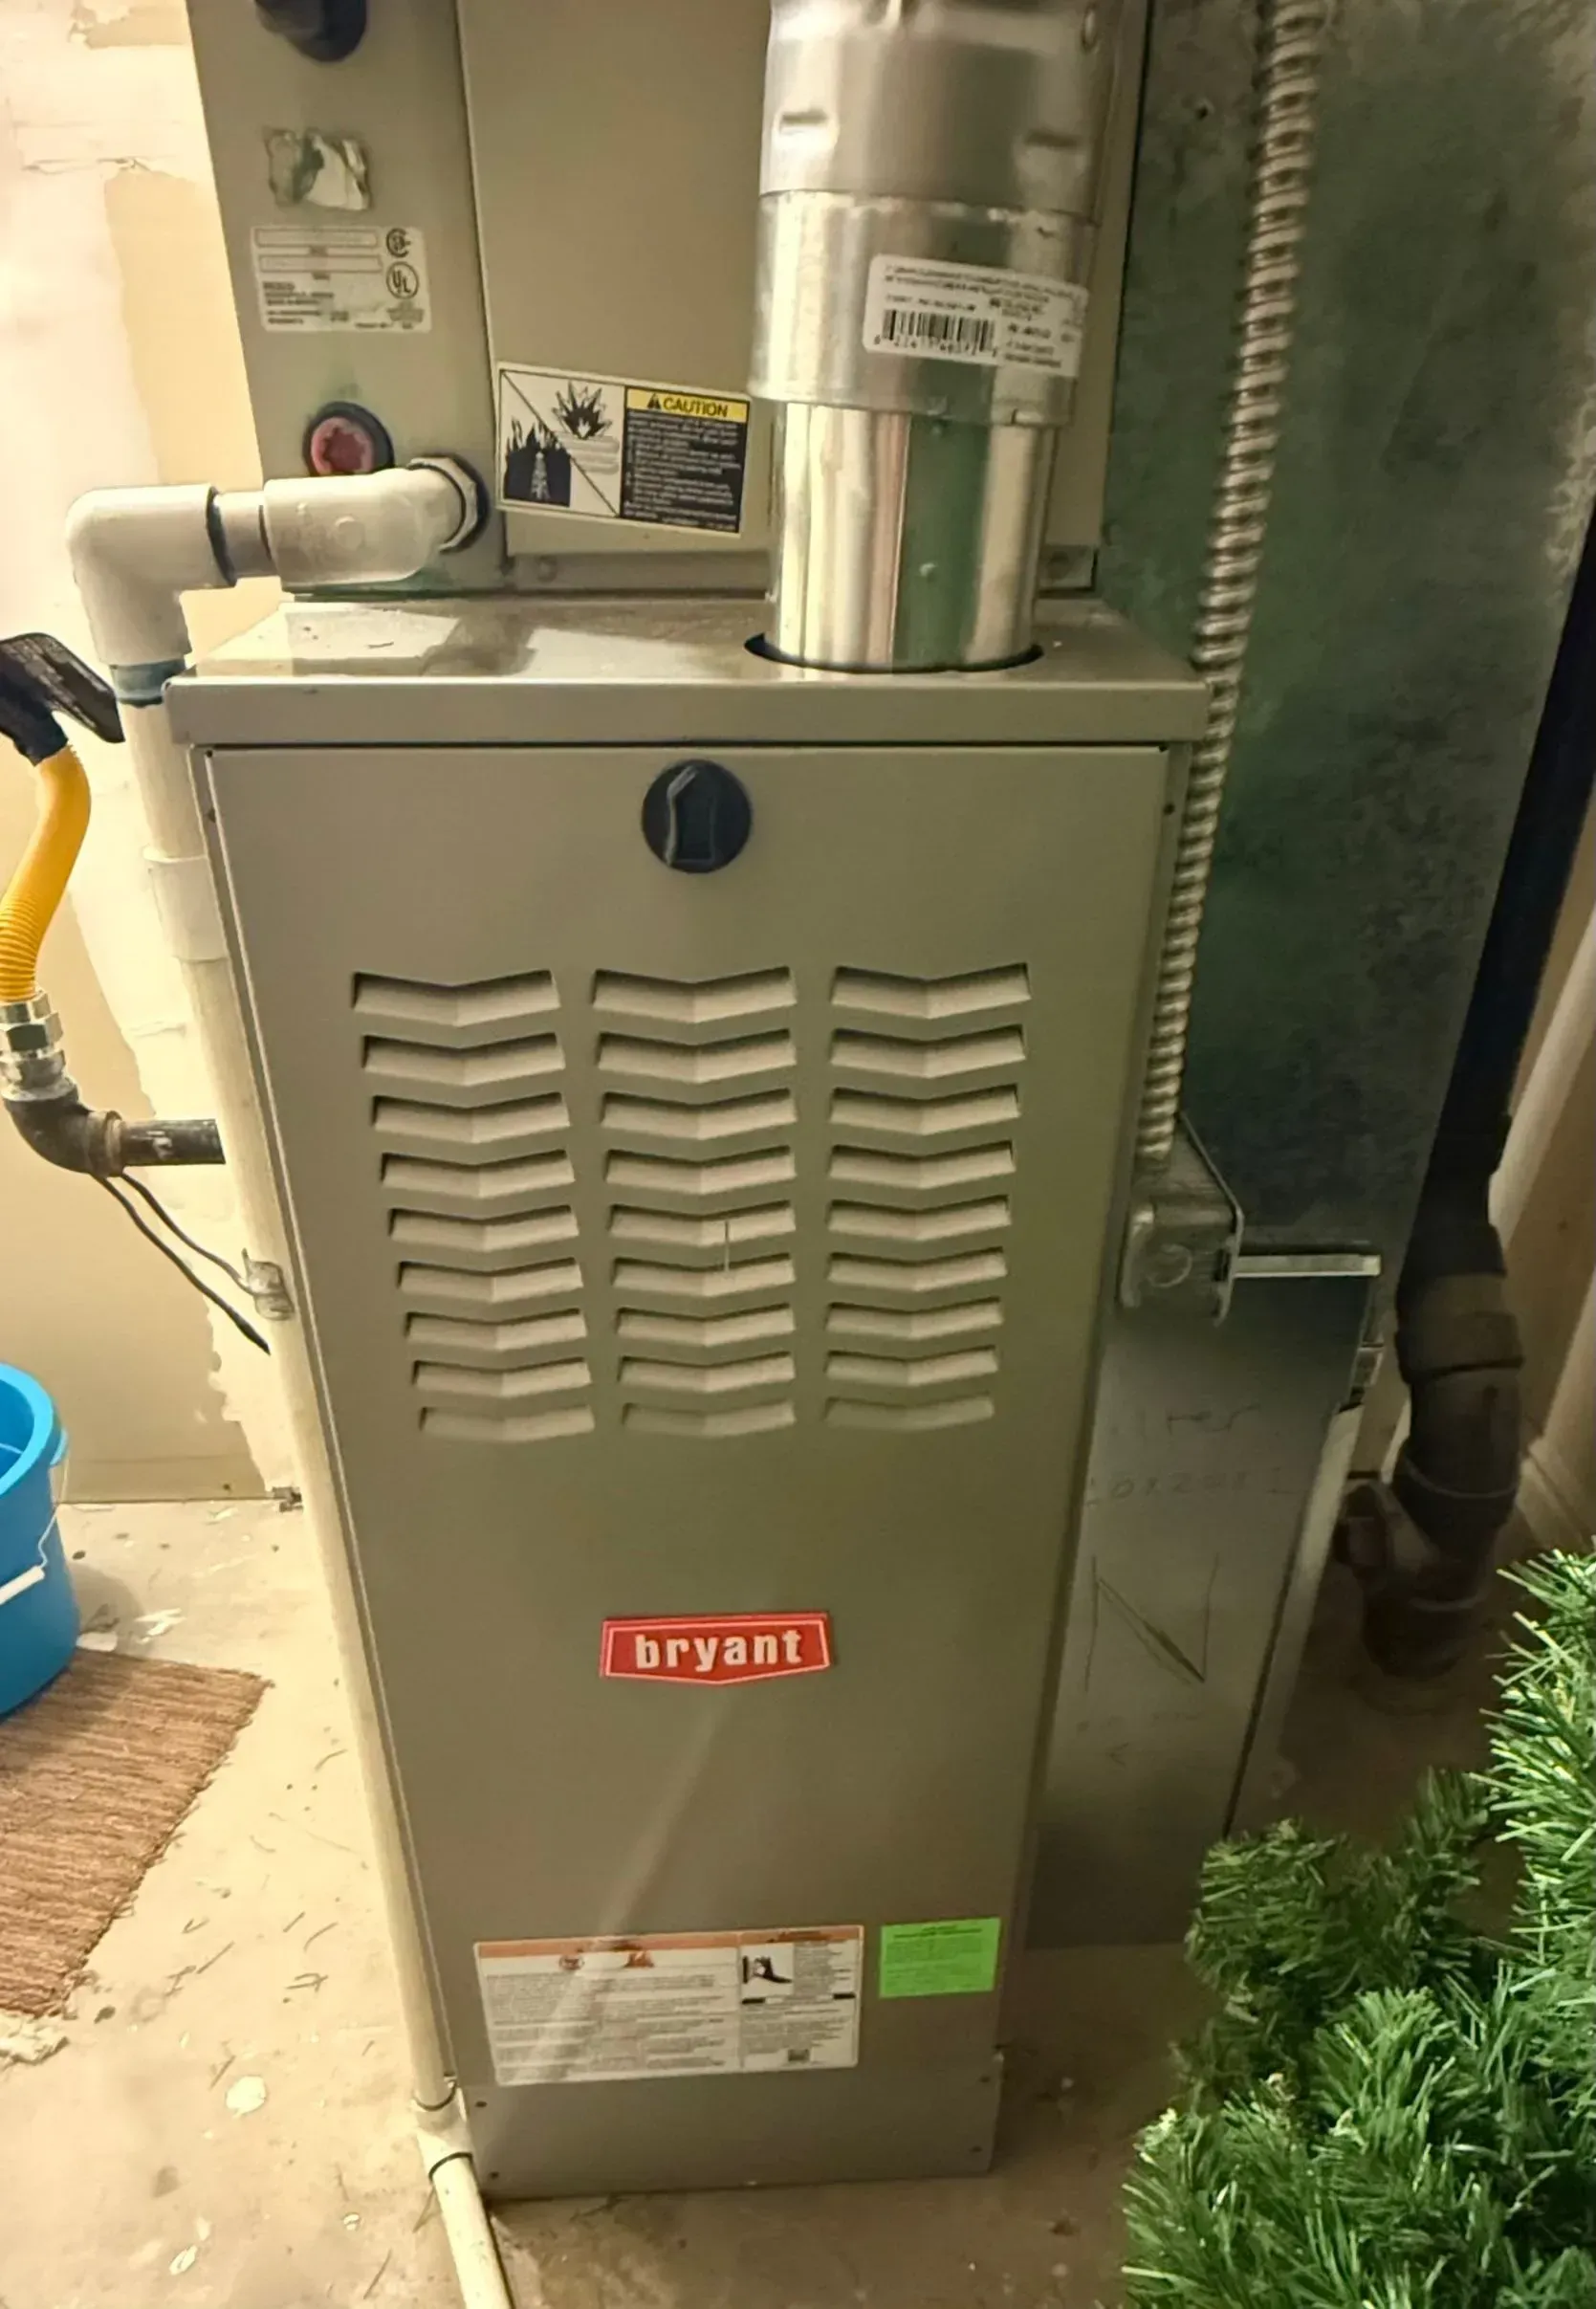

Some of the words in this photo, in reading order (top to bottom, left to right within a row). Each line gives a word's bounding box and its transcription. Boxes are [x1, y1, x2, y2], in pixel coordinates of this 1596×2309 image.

[392, 270, 411, 294] UL
[663, 397, 729, 418] CAUTION
[634, 1629, 802, 1672] bryant
